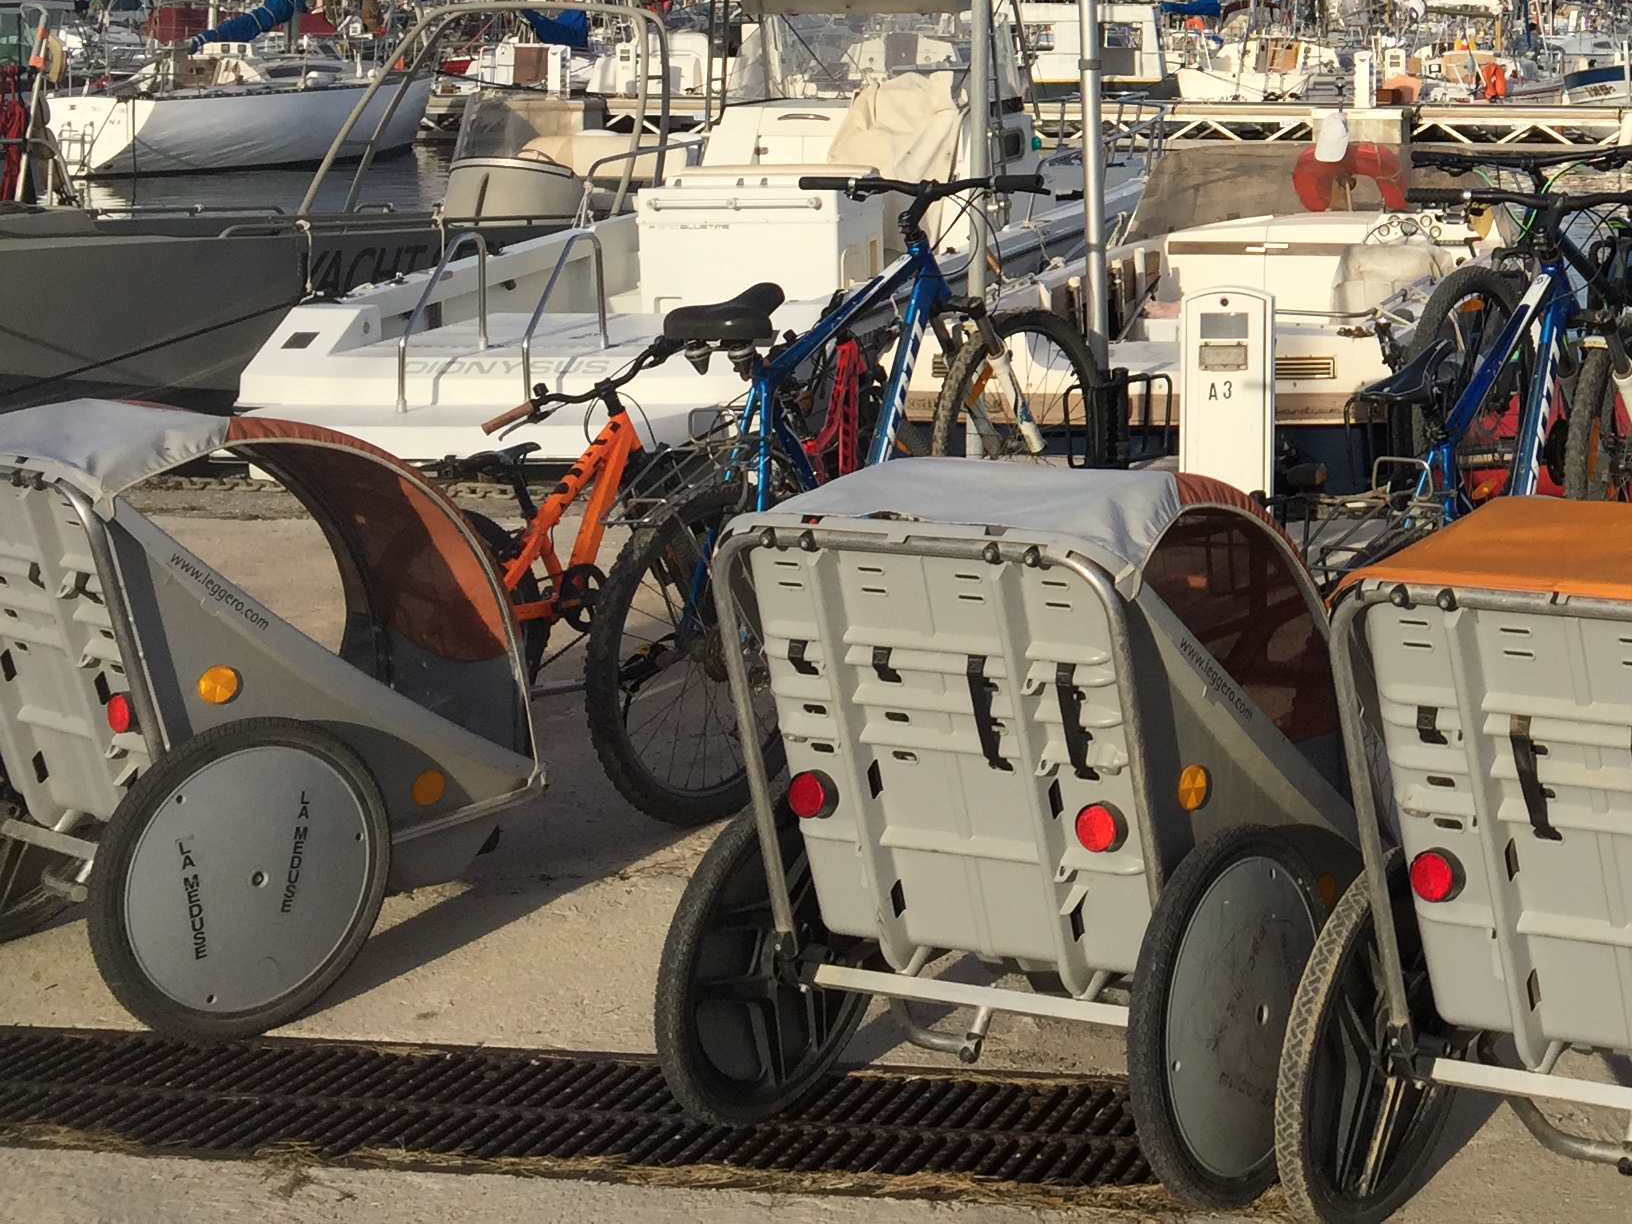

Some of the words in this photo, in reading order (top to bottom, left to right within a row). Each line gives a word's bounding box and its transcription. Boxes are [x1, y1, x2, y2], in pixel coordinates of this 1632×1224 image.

[301, 244, 428, 297] YACHT
[404, 360, 610, 375] DIONYSUS
[1208, 382, 1218, 401] A
[1223, 380, 1232, 399] 3
[170, 553, 269, 631] www.leggero.com
[1180, 637, 1253, 722] www.leggero.com
[297, 791, 310, 819] LA
[178, 841, 196, 871] LA
[280, 826, 308, 913] MEDUSE
[183, 874, 208, 960] MEDUSE
